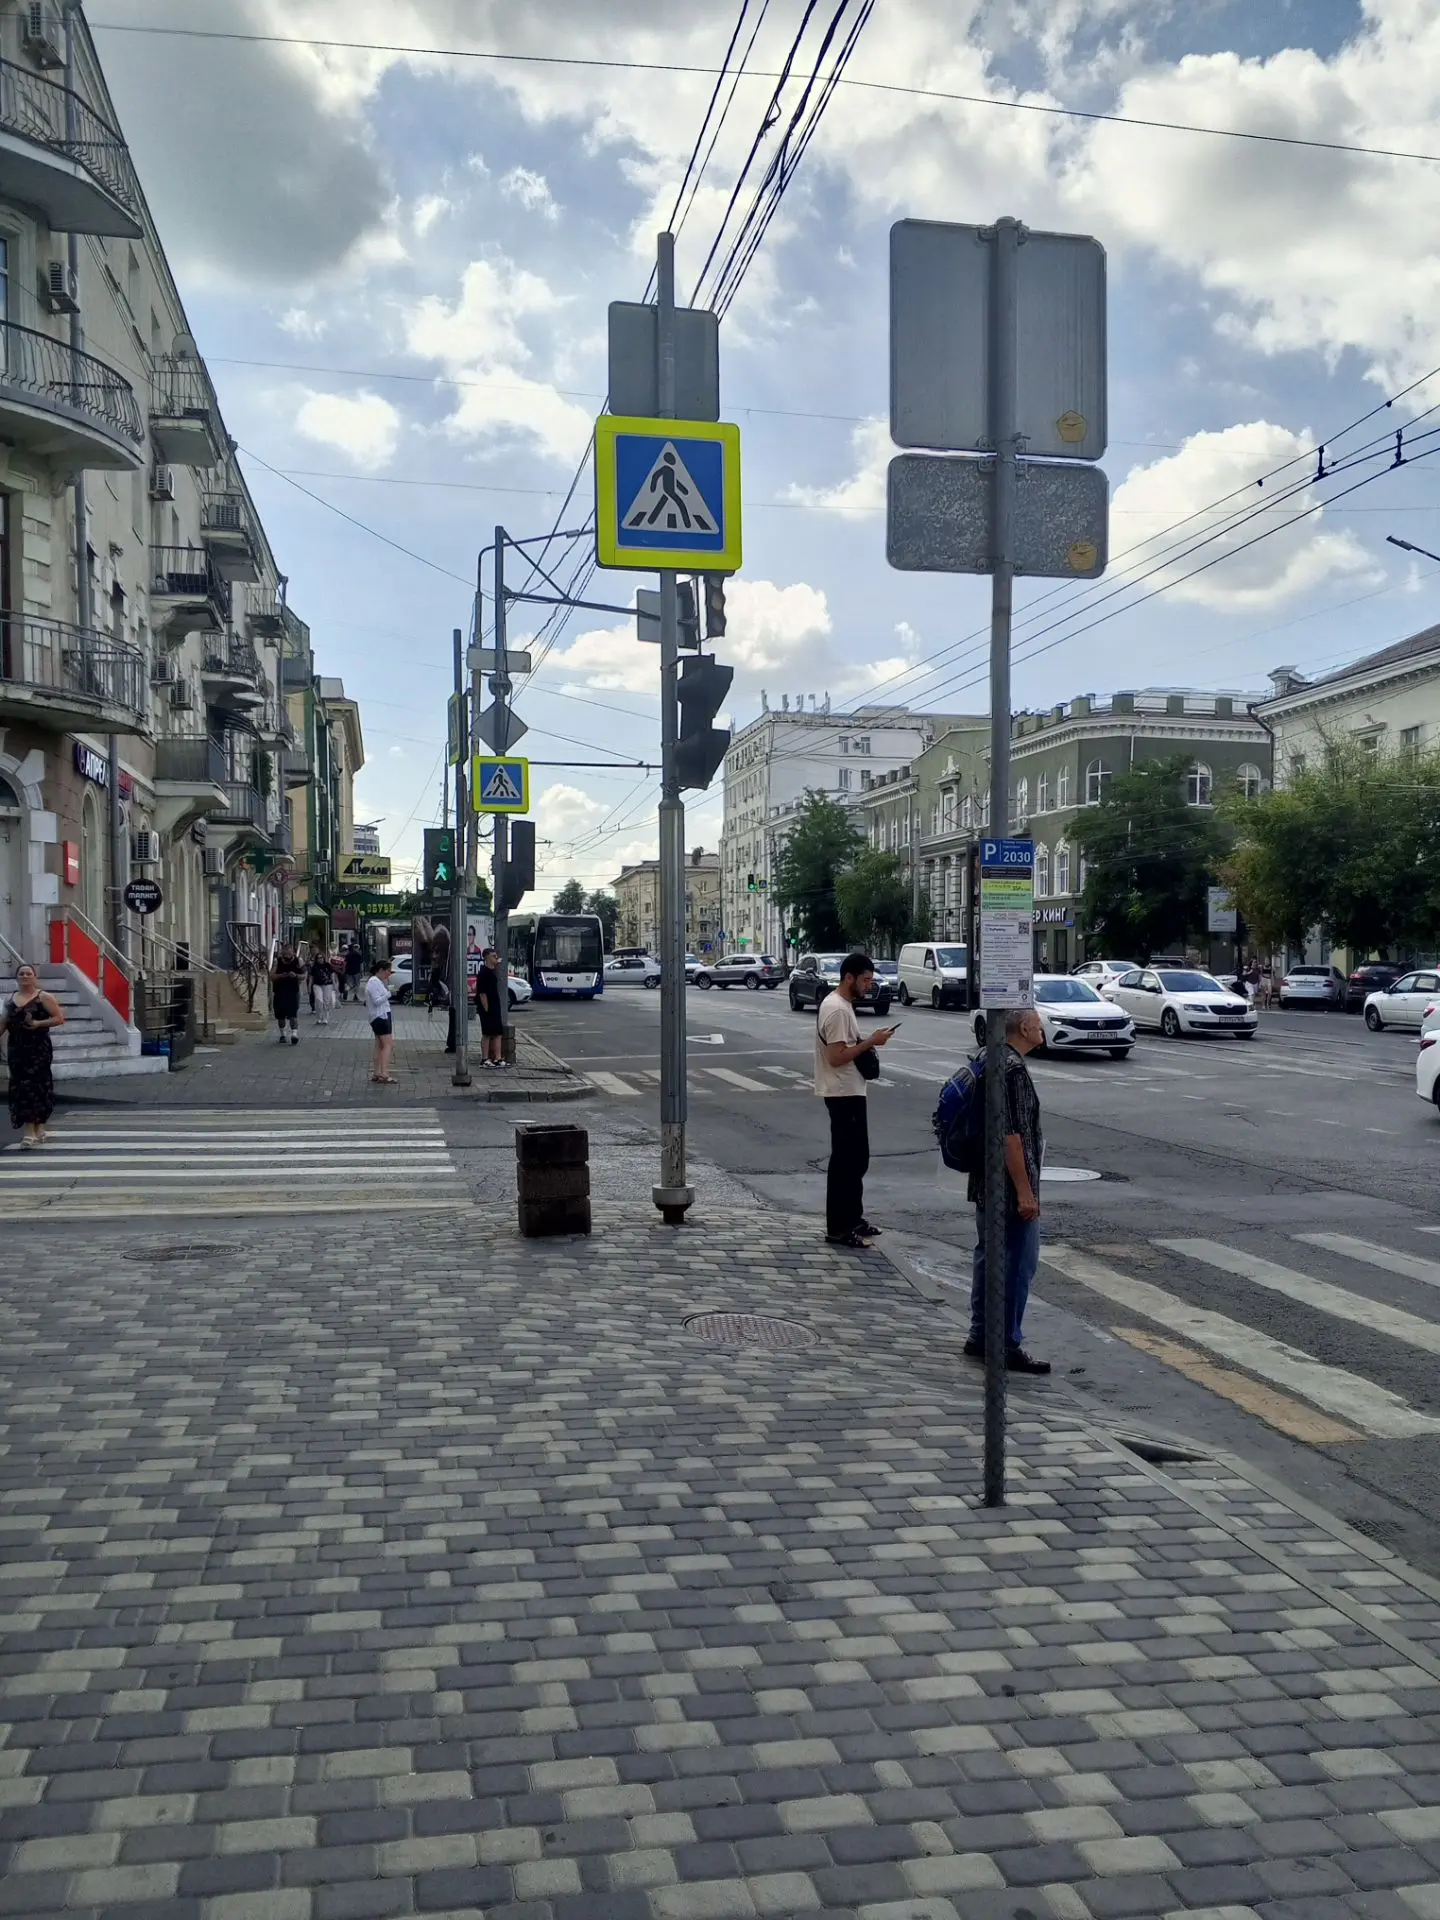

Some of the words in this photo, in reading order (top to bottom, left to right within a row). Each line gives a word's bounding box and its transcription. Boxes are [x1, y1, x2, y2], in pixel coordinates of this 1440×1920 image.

[984, 843, 997, 861] P
[1003, 851, 1031, 863] 2030
[1042, 907, 1066, 923] КИНГ
